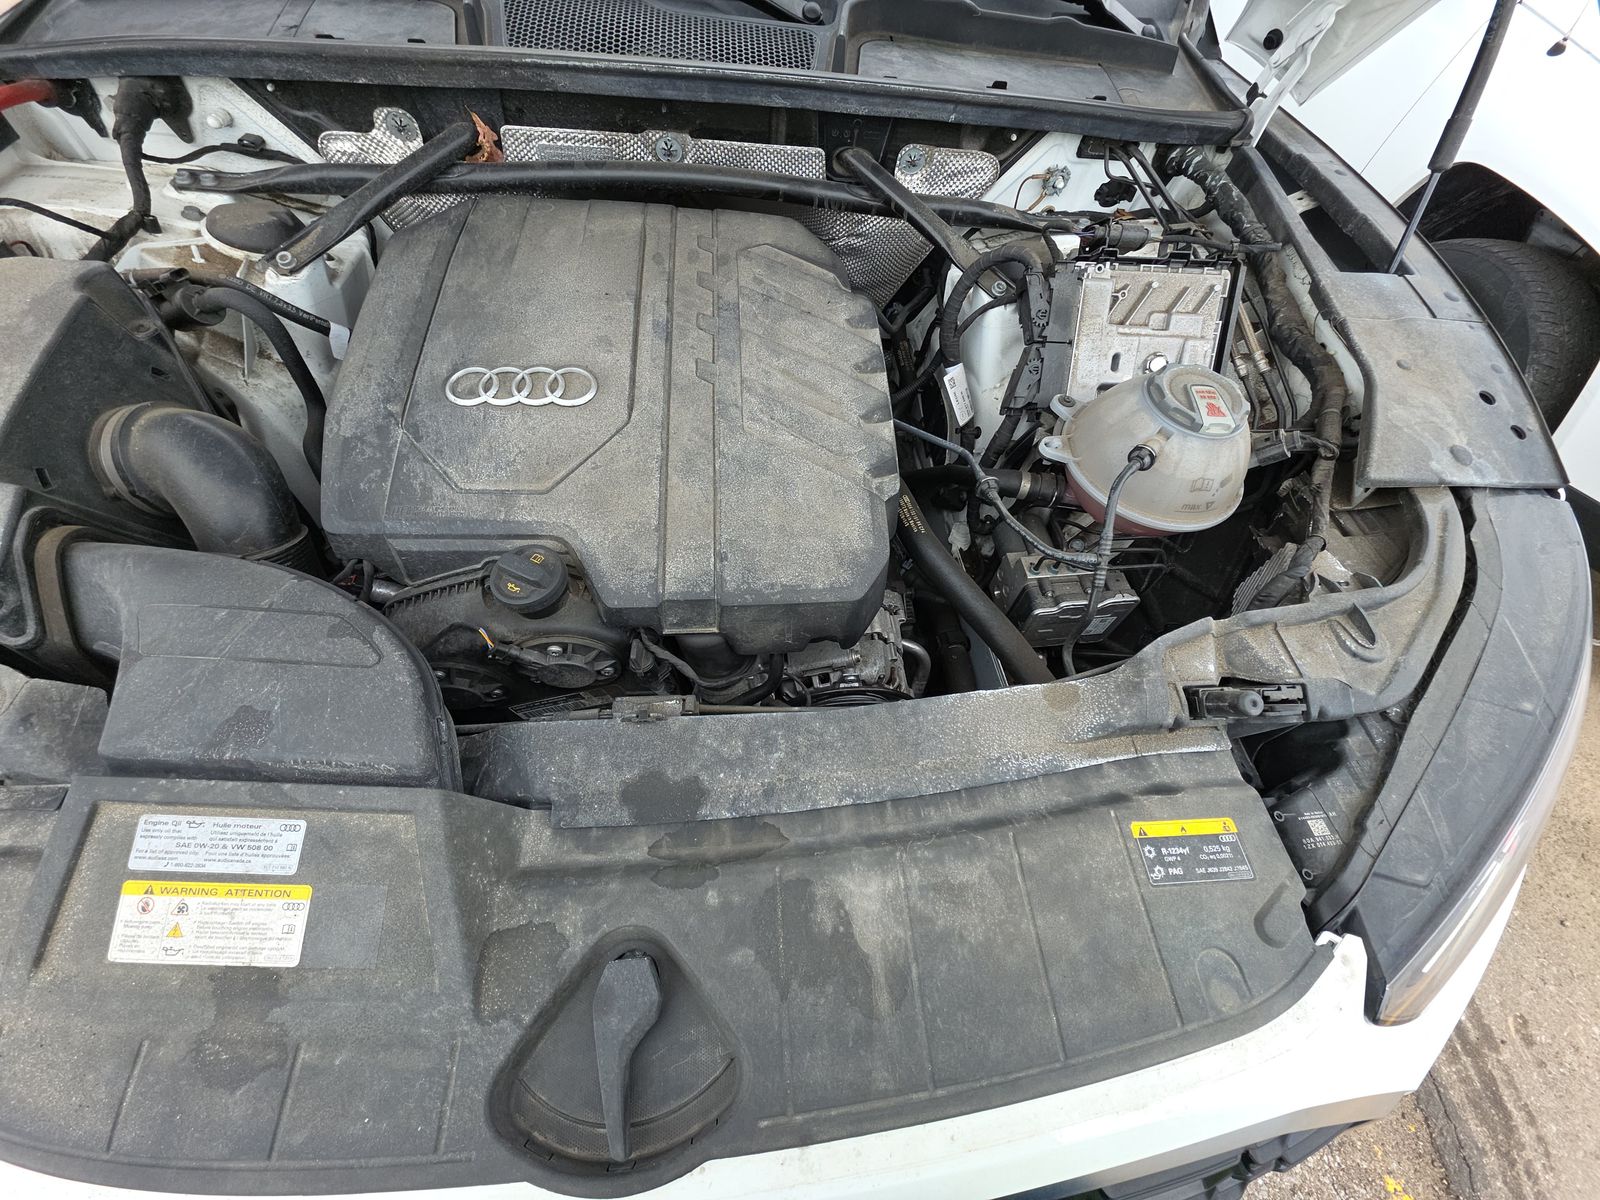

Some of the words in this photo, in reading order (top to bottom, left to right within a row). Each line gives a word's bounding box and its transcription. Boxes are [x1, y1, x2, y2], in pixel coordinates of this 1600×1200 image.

[1181, 503, 1202, 511] max
[1161, 846, 1190, 855] R-1234yf
[160, 886, 218, 896] WARNING
[225, 888, 292, 898] ATTENTION
